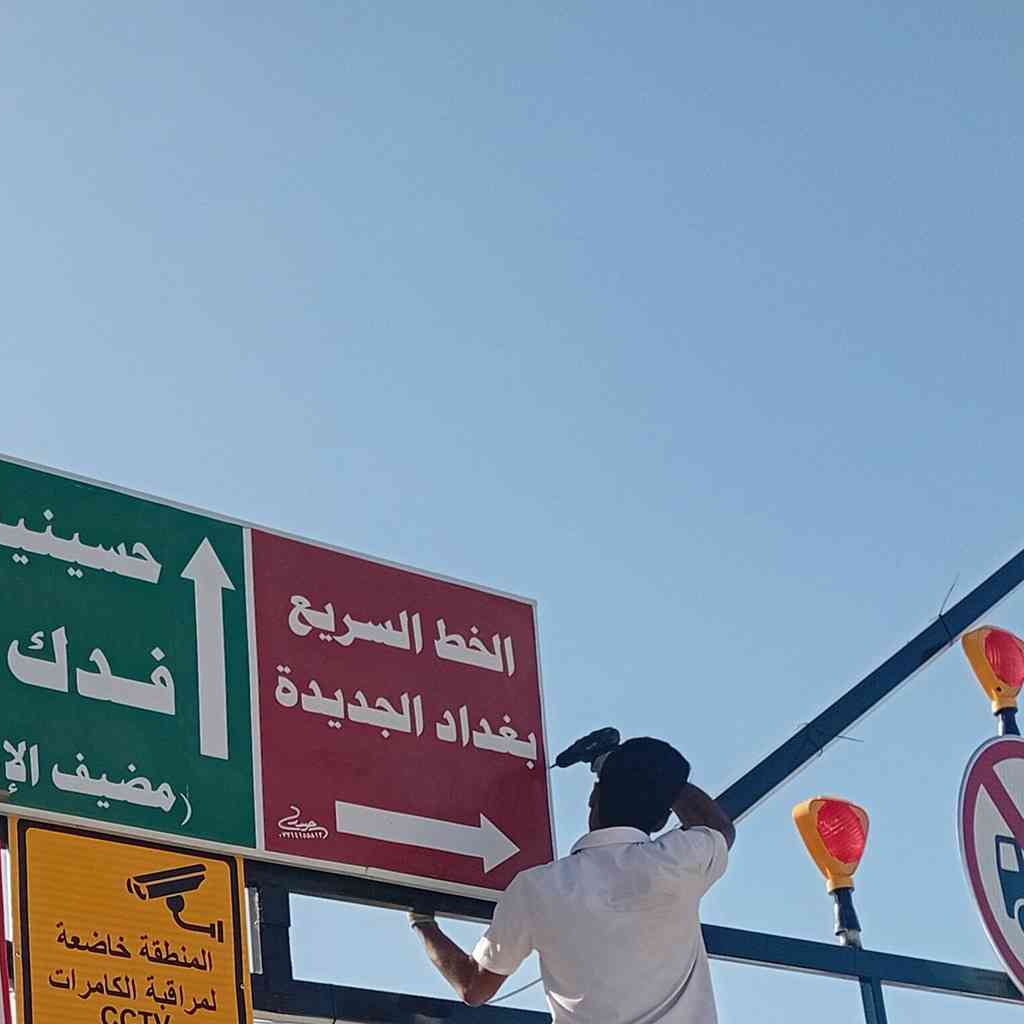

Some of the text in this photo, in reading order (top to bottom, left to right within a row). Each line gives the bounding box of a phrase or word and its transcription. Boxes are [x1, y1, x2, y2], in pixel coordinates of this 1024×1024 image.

[7, 626, 176, 715] فدك
[289, 595, 516, 677] الخط السريع
[275, 664, 538, 769] بغداد الجديدة
[56, 921, 213, 972] المنطقة خاضعة
[48, 968, 217, 1015] لمراقبة الكامرات
